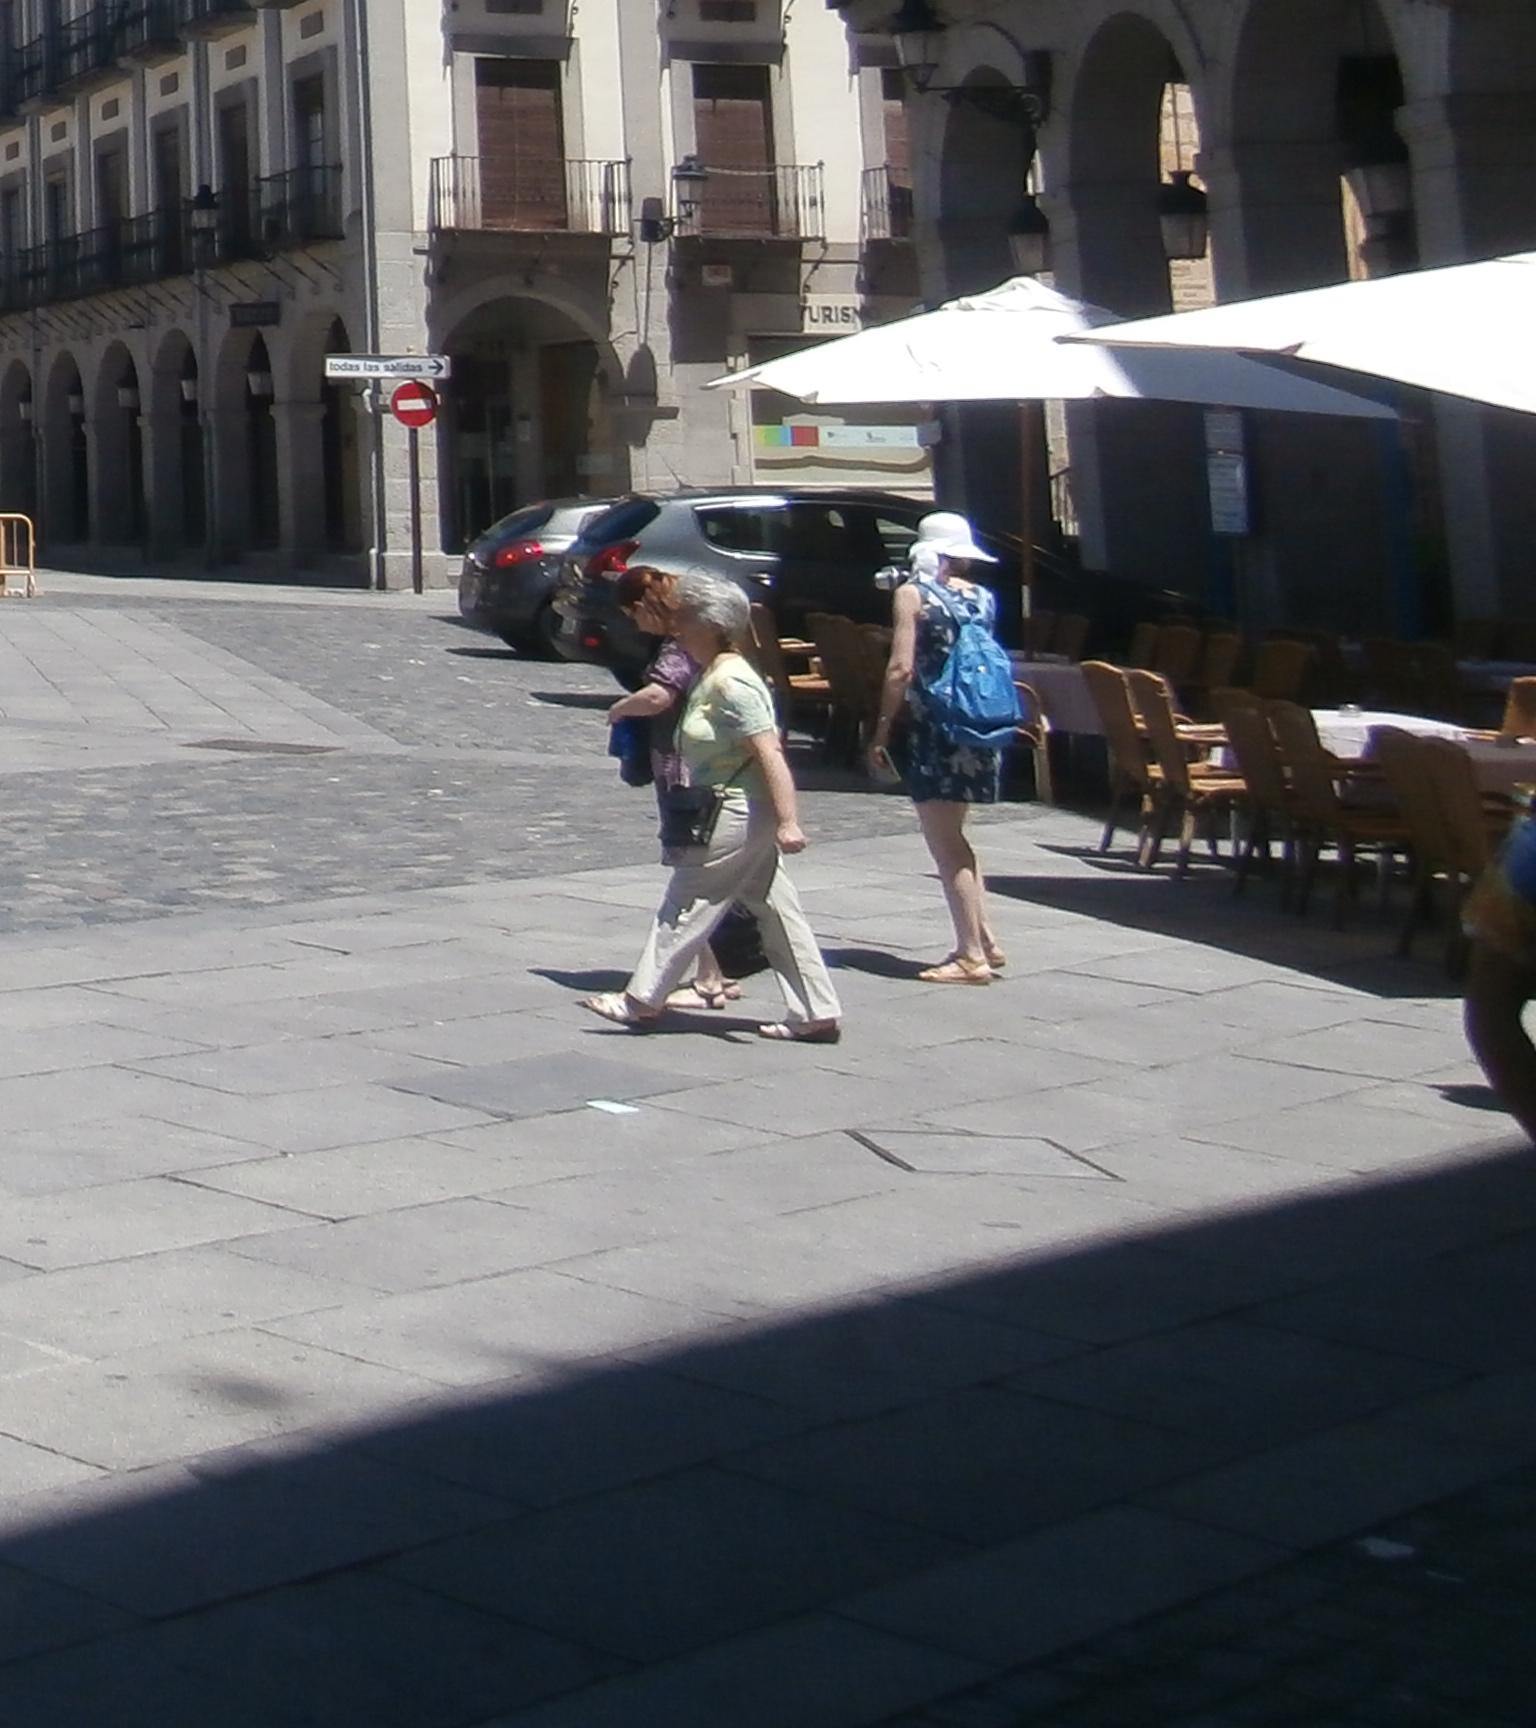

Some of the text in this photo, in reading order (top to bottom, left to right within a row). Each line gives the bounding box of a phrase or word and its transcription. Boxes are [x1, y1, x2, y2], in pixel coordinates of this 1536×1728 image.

[329, 362, 423, 372] todas las salidas
